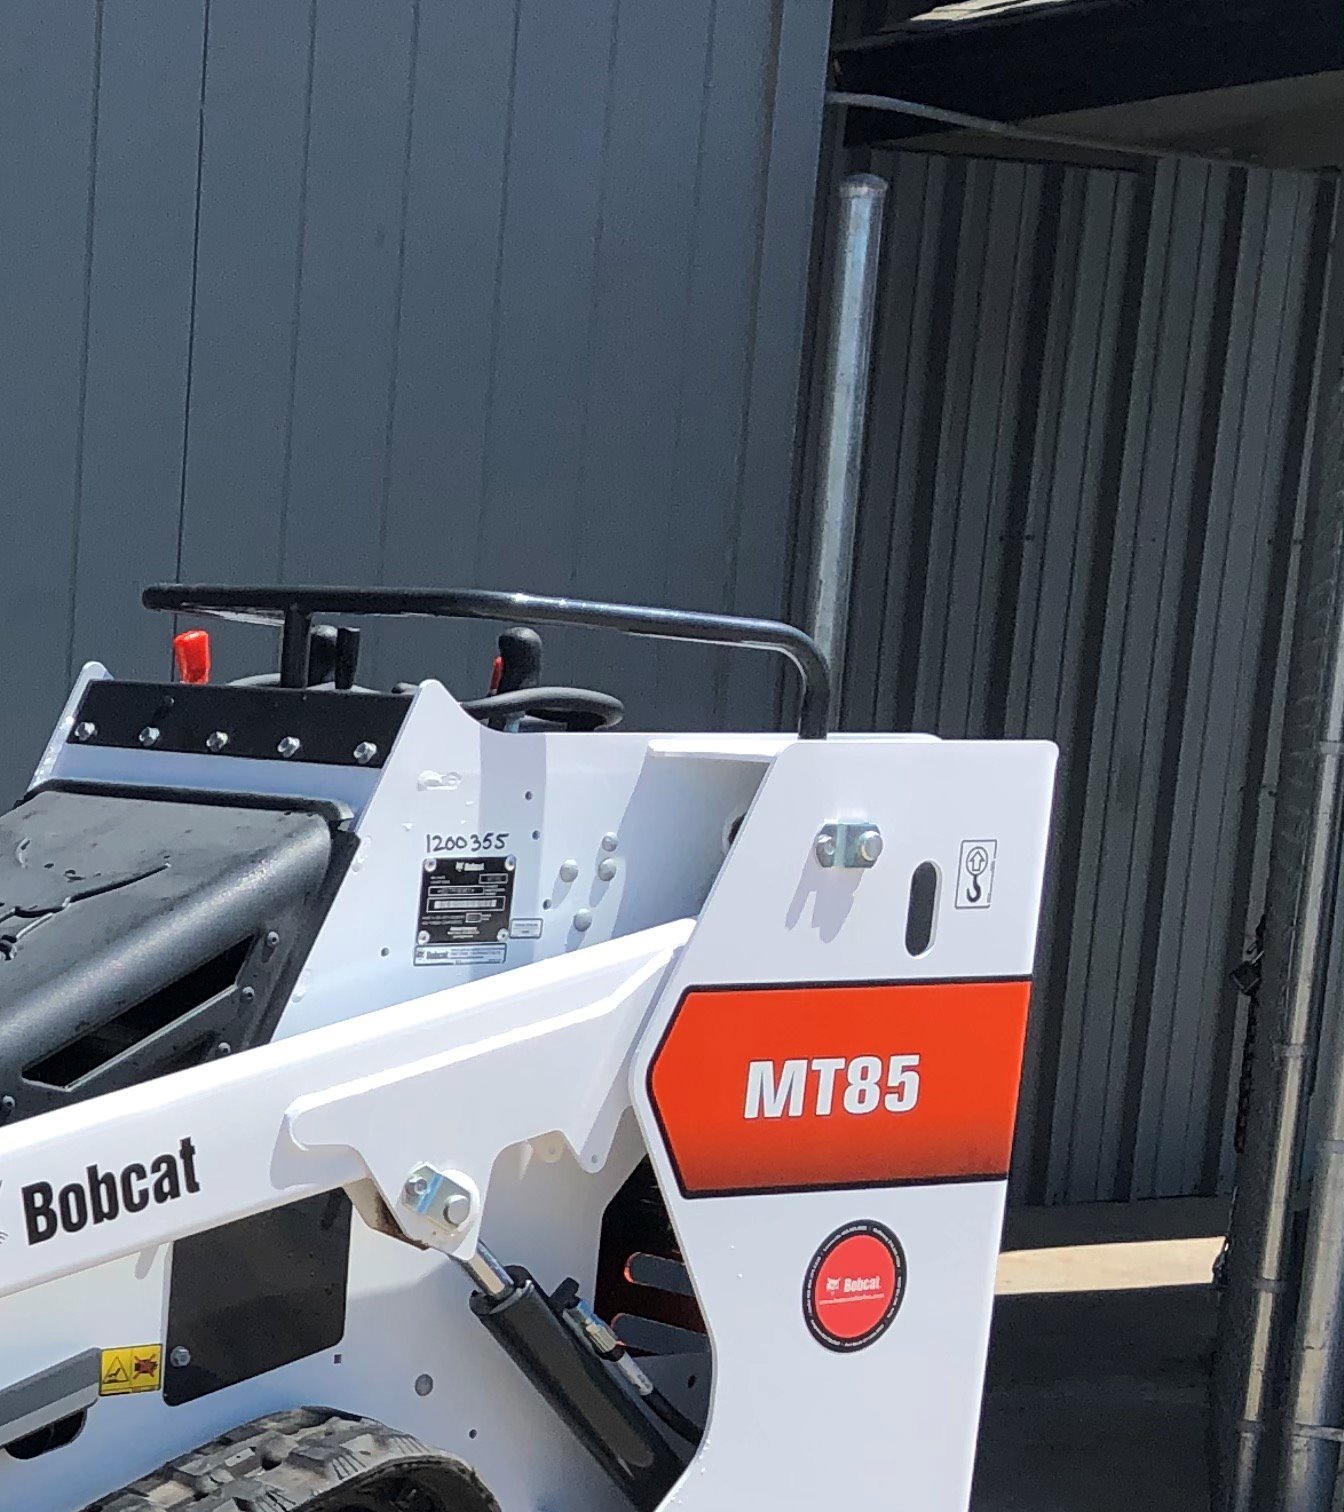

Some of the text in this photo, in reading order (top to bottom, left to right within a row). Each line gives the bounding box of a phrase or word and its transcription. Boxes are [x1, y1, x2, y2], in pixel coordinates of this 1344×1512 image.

[425, 833, 510, 853] 1200355
[743, 1053, 922, 1120] MT85
[21, 1136, 201, 1246] Bobcat
[843, 1275, 881, 1293] Bobcat
